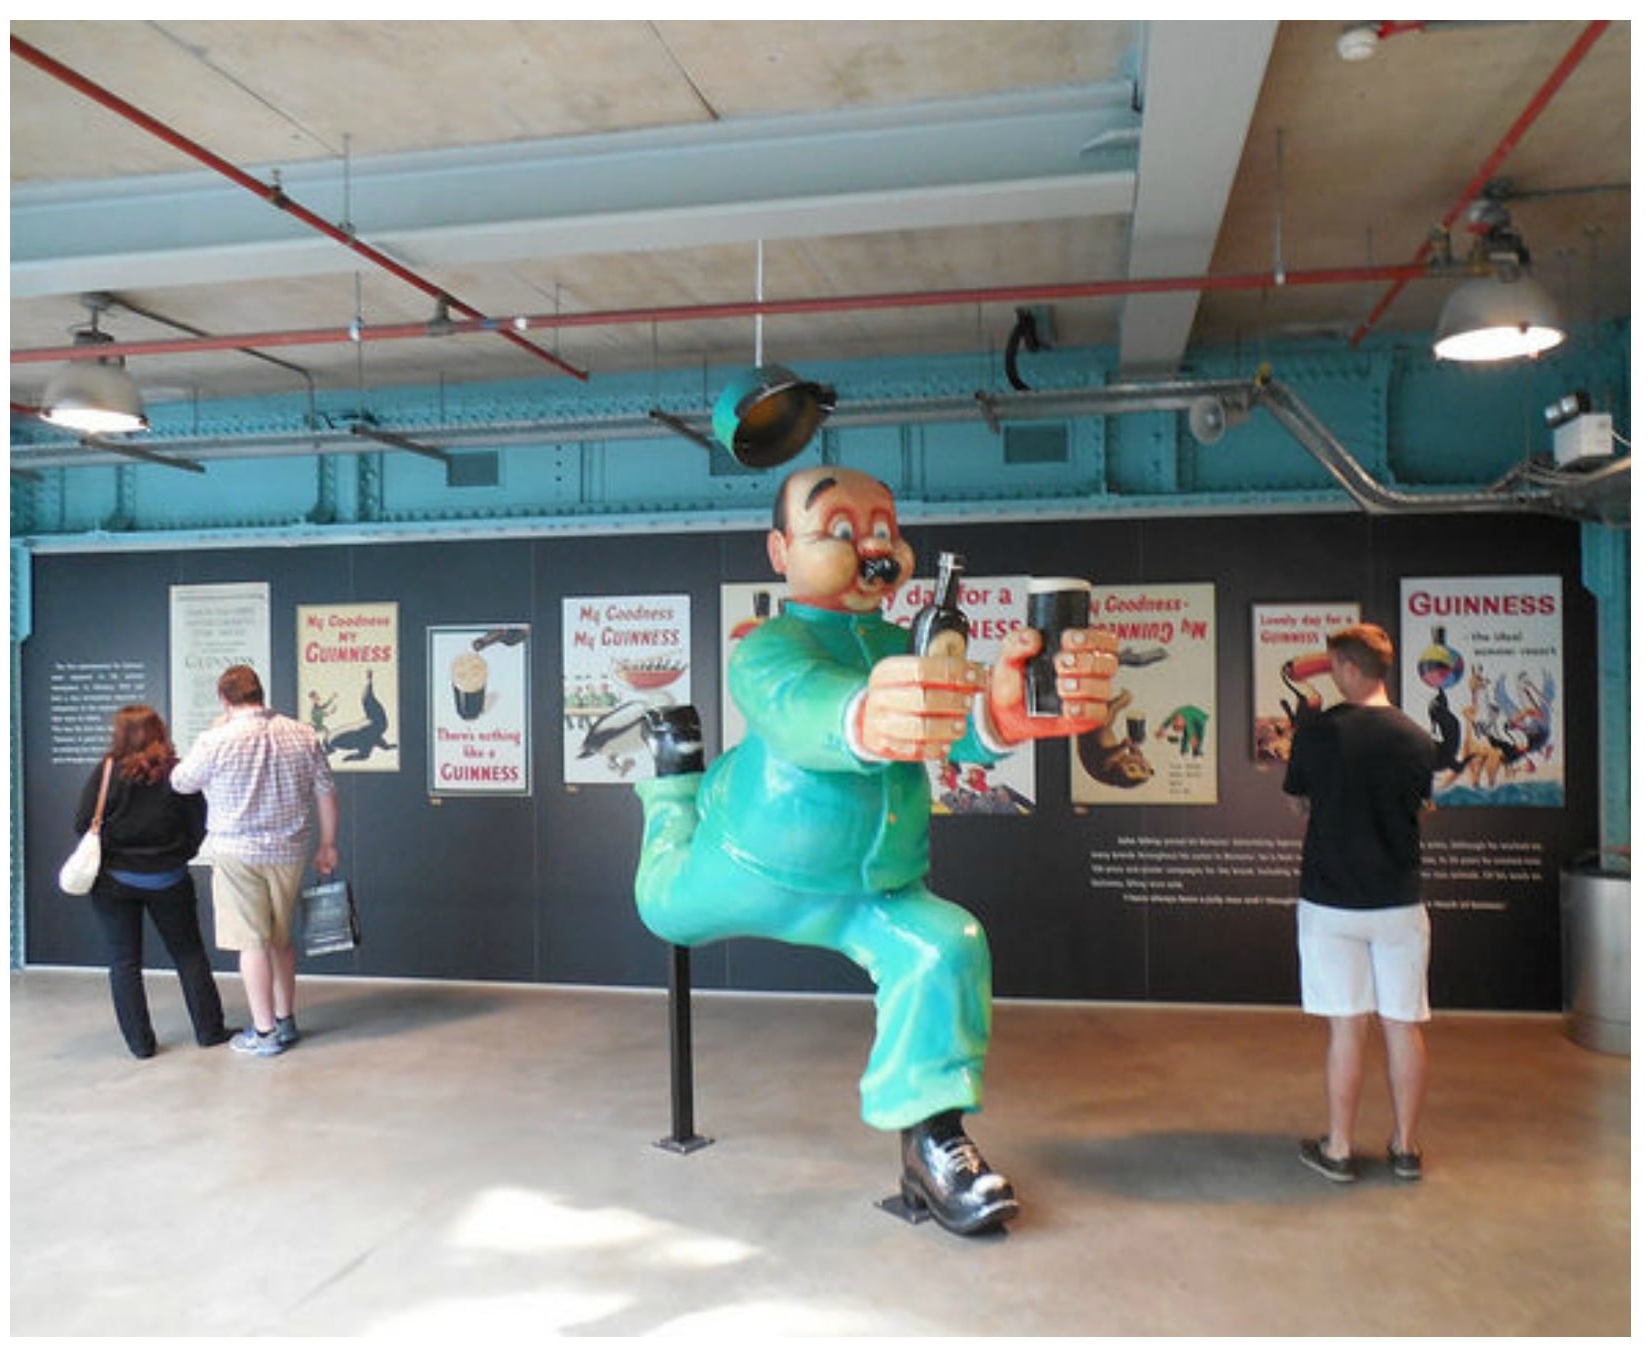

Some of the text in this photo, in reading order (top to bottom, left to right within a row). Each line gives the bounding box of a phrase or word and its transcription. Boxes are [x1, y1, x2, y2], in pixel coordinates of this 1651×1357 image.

[956, 584, 989, 605] for
[999, 588, 1013, 605] a
[1408, 591, 1555, 616] GUINNESS
[328, 614, 390, 628] Goodness
[580, 604, 675, 625] My Goodness
[574, 627, 681, 650] My GUINNESS
[305, 641, 392, 663] GUINNESS
[437, 727, 520, 746] There's nothing
[463, 743, 485, 758] like
[440, 763, 519, 781] GUINNESS
